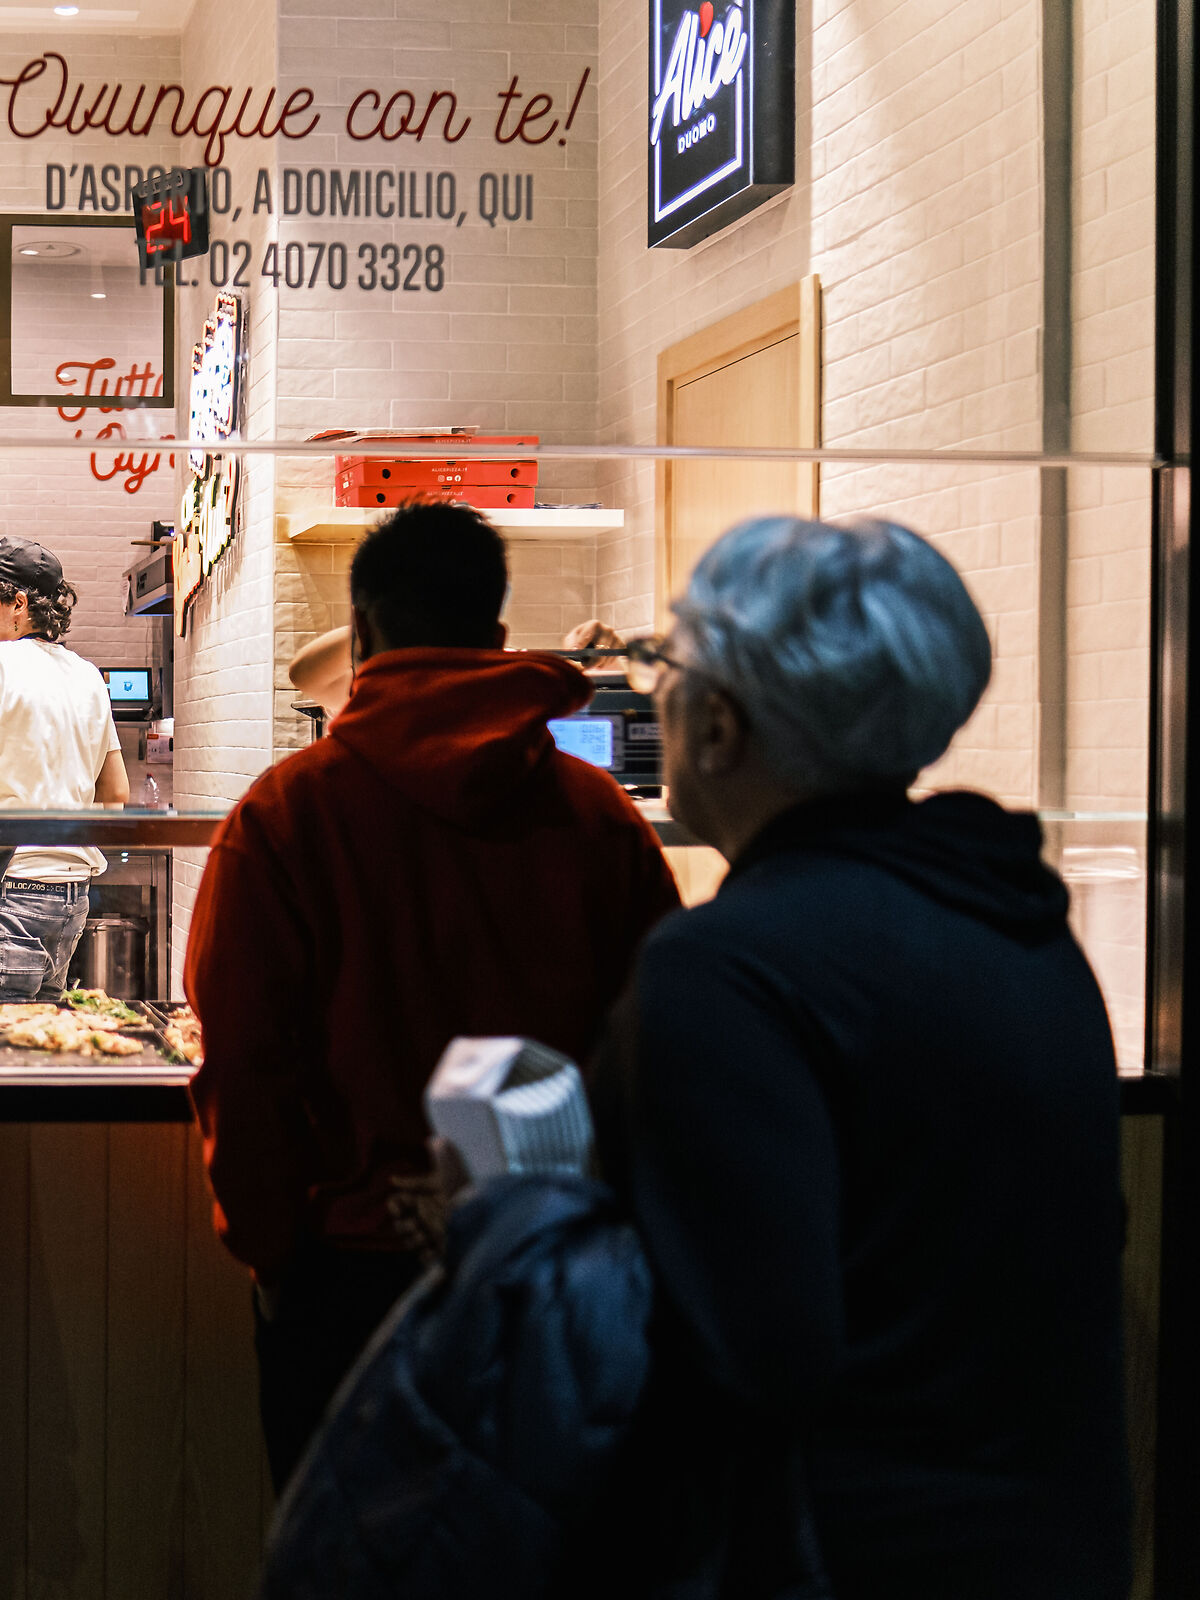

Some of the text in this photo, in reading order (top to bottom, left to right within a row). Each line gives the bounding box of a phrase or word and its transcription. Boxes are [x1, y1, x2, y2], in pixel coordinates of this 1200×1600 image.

[346, 87, 470, 142] con
[493, 66, 591, 147] te!
[677, 112, 717, 154] DUOMO
[146, 195, 191, 254] 24
[252, 168, 273, 214] A
[283, 168, 468, 228] DOMICILIO,
[479, 172, 534, 223] QUI
[136, 238, 445, 292] TEL. 02 4070 3328
